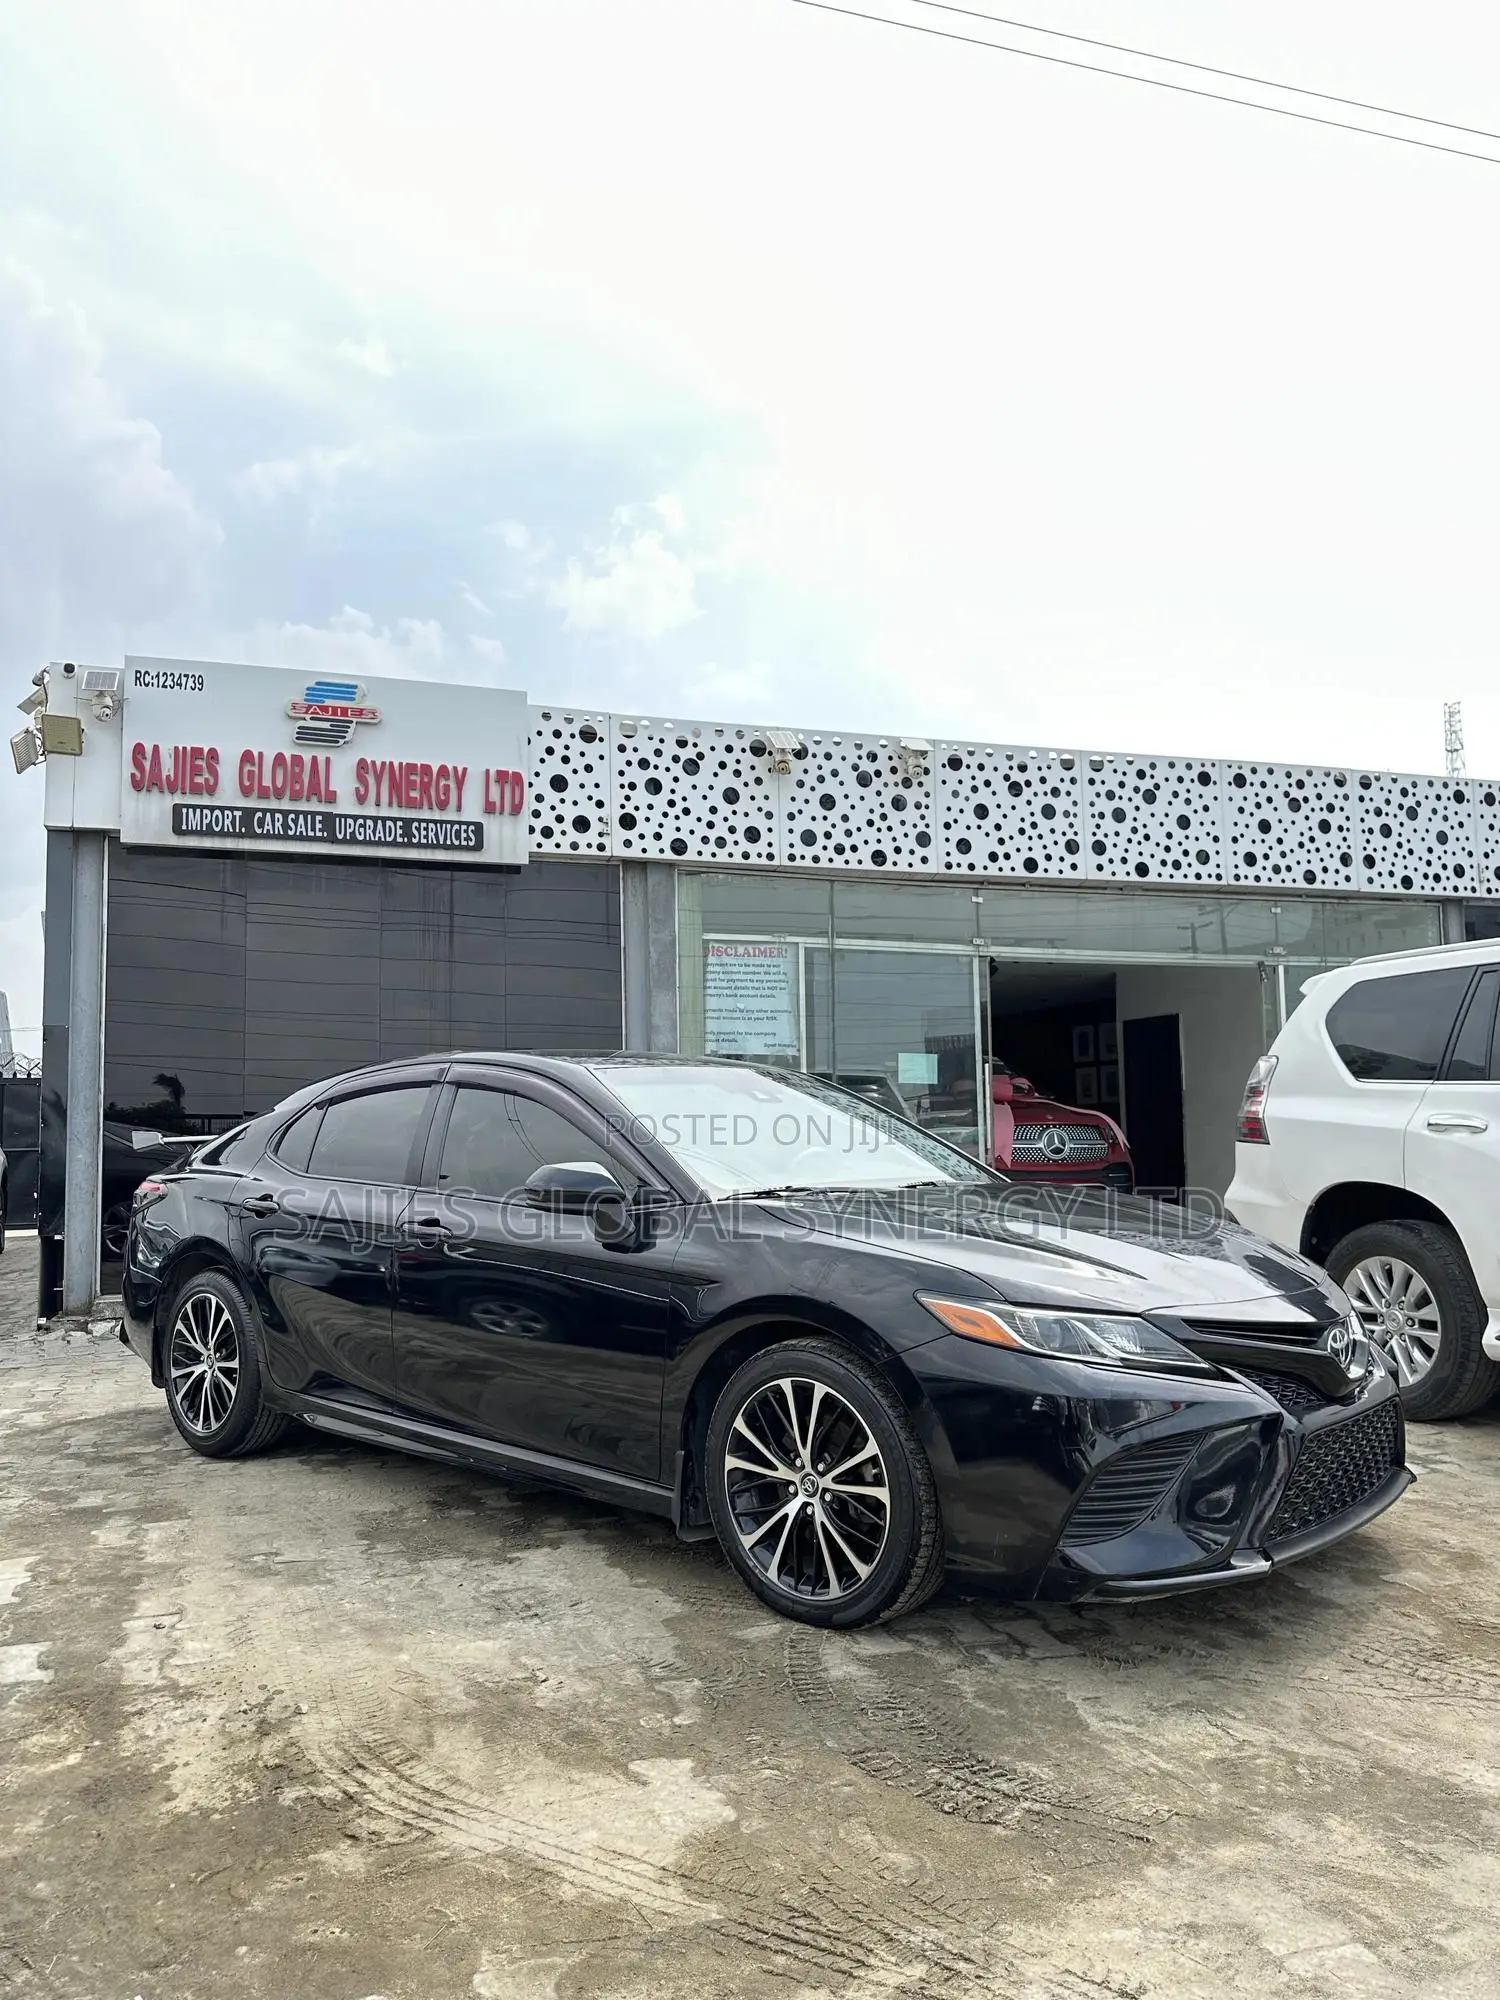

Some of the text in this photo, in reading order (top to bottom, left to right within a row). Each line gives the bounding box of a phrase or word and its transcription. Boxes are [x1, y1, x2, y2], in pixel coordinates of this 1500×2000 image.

[134, 669, 204, 691] RC:1234739
[290, 702, 379, 719] SAJIES
[130, 742, 525, 816] SAJIES GLOBAL SYNERGY LTD
[181, 807, 476, 846] IMPORT. CAR SALE. UPGRADE. SERVICES
